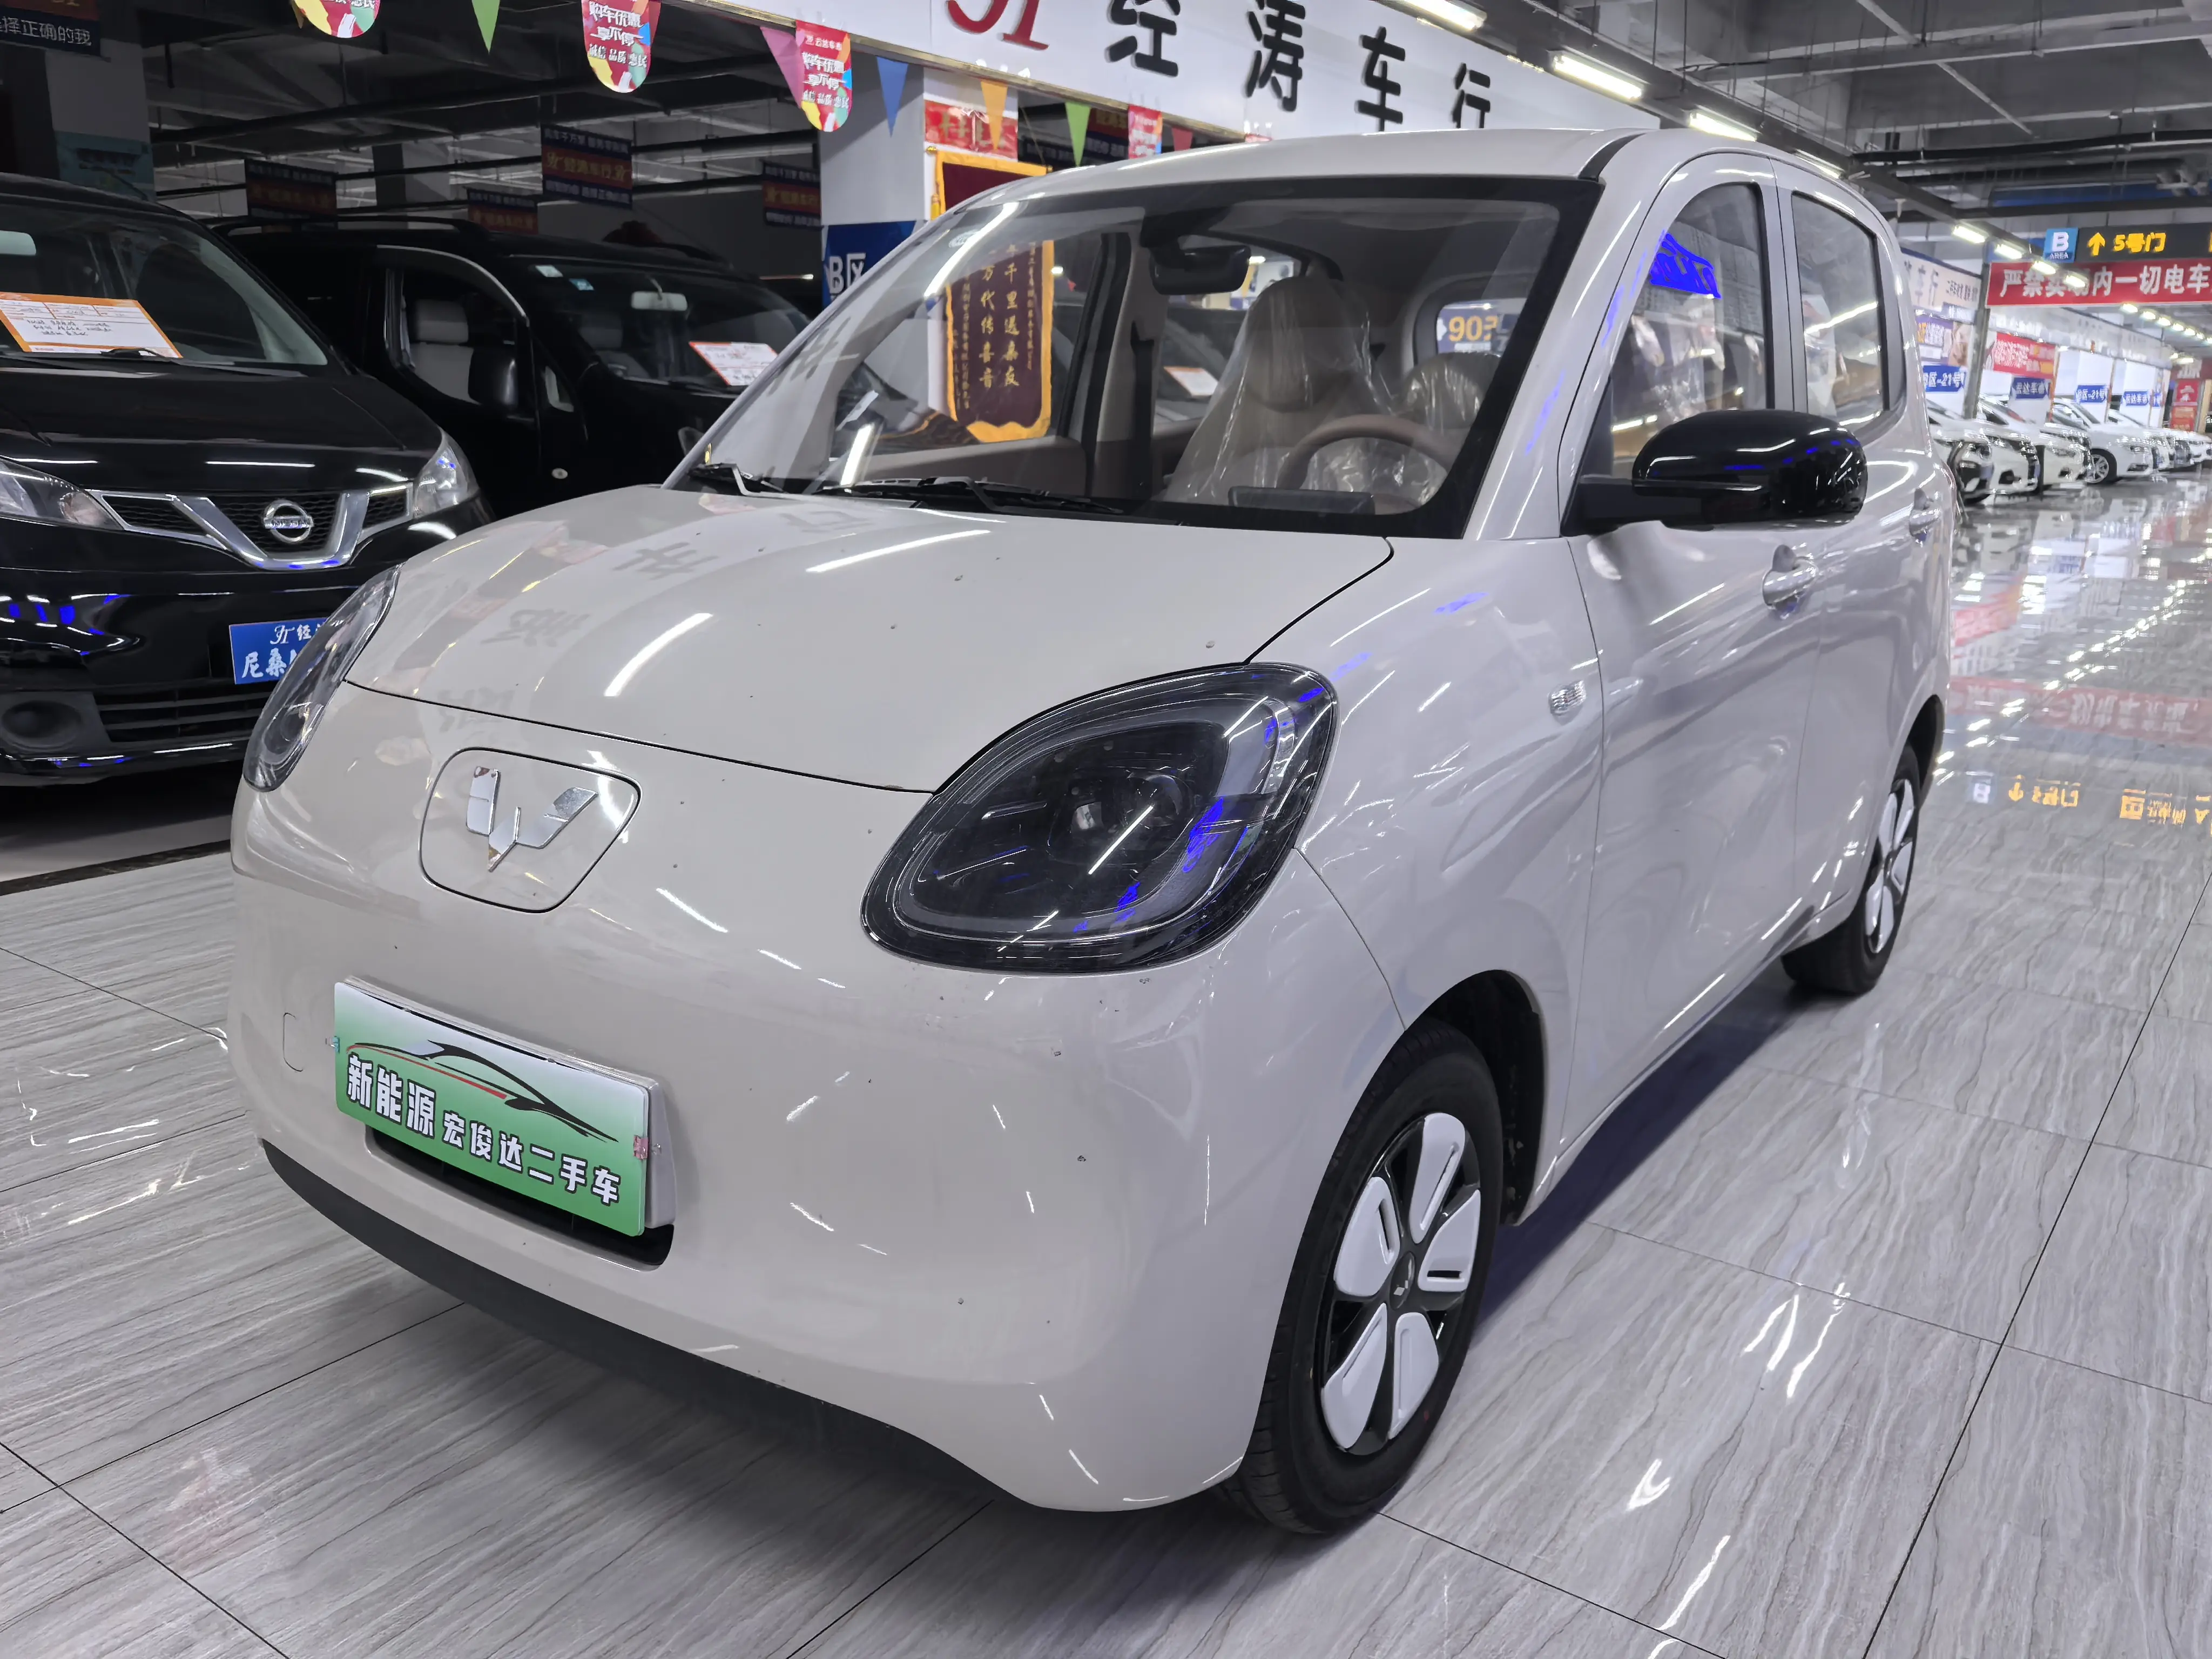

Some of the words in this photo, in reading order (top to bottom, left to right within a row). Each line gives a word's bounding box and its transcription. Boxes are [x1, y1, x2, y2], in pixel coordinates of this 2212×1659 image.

[0, 16, 92, 46] 择正确的我
[2054, 232, 2069, 252] B
[2114, 232, 2166, 253] 5号门
[347, 1053, 436, 1138] 新能源
[442, 1109, 621, 1206] 宏俊达二手车
